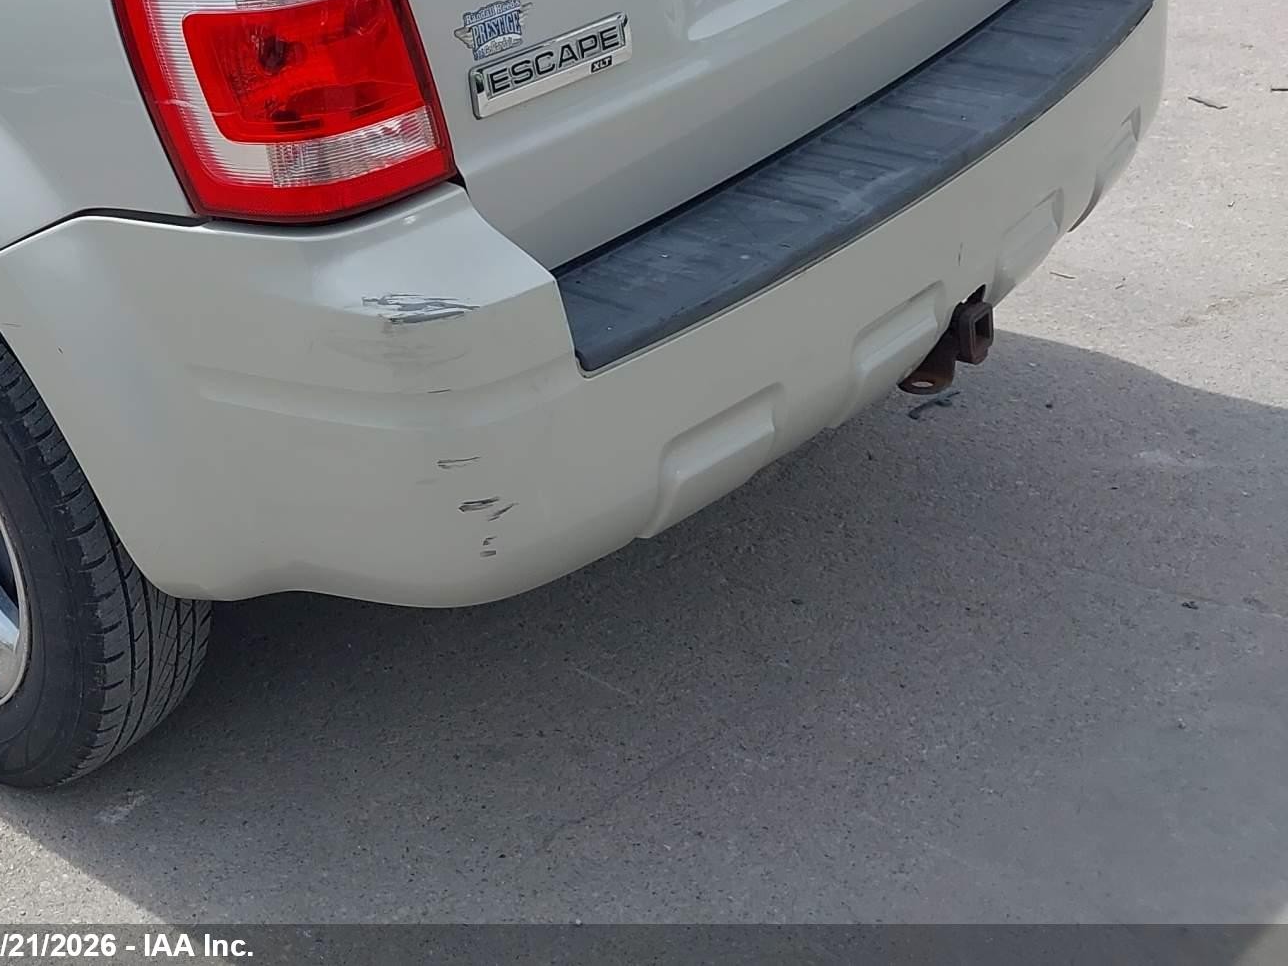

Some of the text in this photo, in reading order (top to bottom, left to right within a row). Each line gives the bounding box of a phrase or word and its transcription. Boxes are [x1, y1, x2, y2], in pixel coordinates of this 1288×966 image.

[472, 11, 521, 50] PRESTIGE
[489, 25, 620, 94] ESCAPE
[593, 57, 611, 71] XLT
